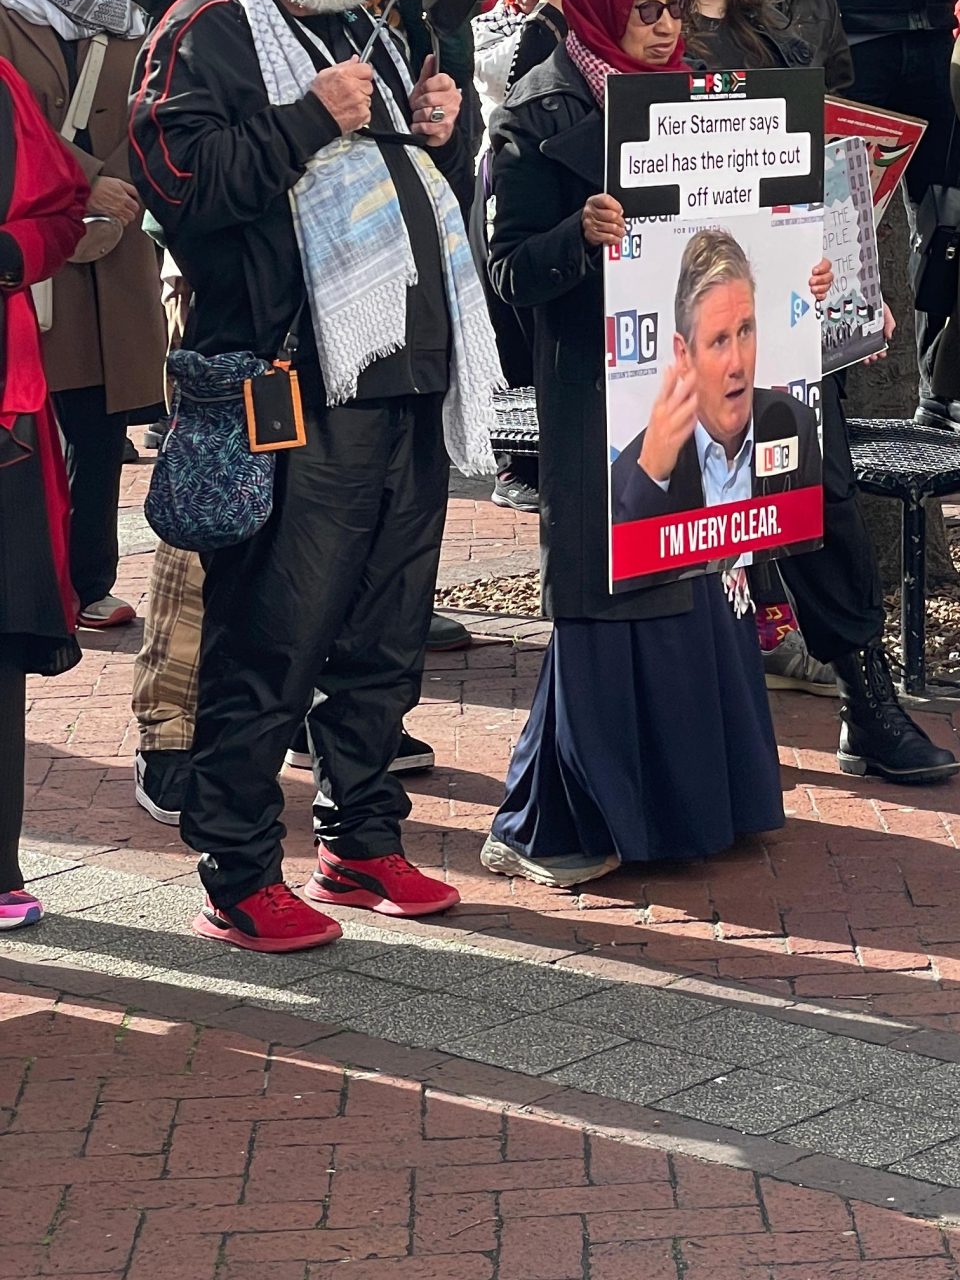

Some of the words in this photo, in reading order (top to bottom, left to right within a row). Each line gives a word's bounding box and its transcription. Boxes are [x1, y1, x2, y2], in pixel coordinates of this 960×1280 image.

[705, 73, 730, 93] PSC
[657, 116, 686, 136] Kier
[690, 114, 746, 134] Starmer
[749, 115, 779, 135] says
[629, 154, 668, 174] Israel
[672, 153, 697, 172] has
[701, 151, 724, 170] the
[727, 149, 759, 173] right
[763, 149, 776, 166] to
[779, 146, 801, 165] cut
[687, 187, 709, 207] off
[712, 188, 752, 205] water
[611, 235, 641, 258] LBC
[607, 316, 655, 358] BC
[765, 446, 789, 470] LBC
[660, 524, 684, 559] I'M
[687, 515, 729, 553] VERY
[730, 505, 782, 544] CLEAR.
